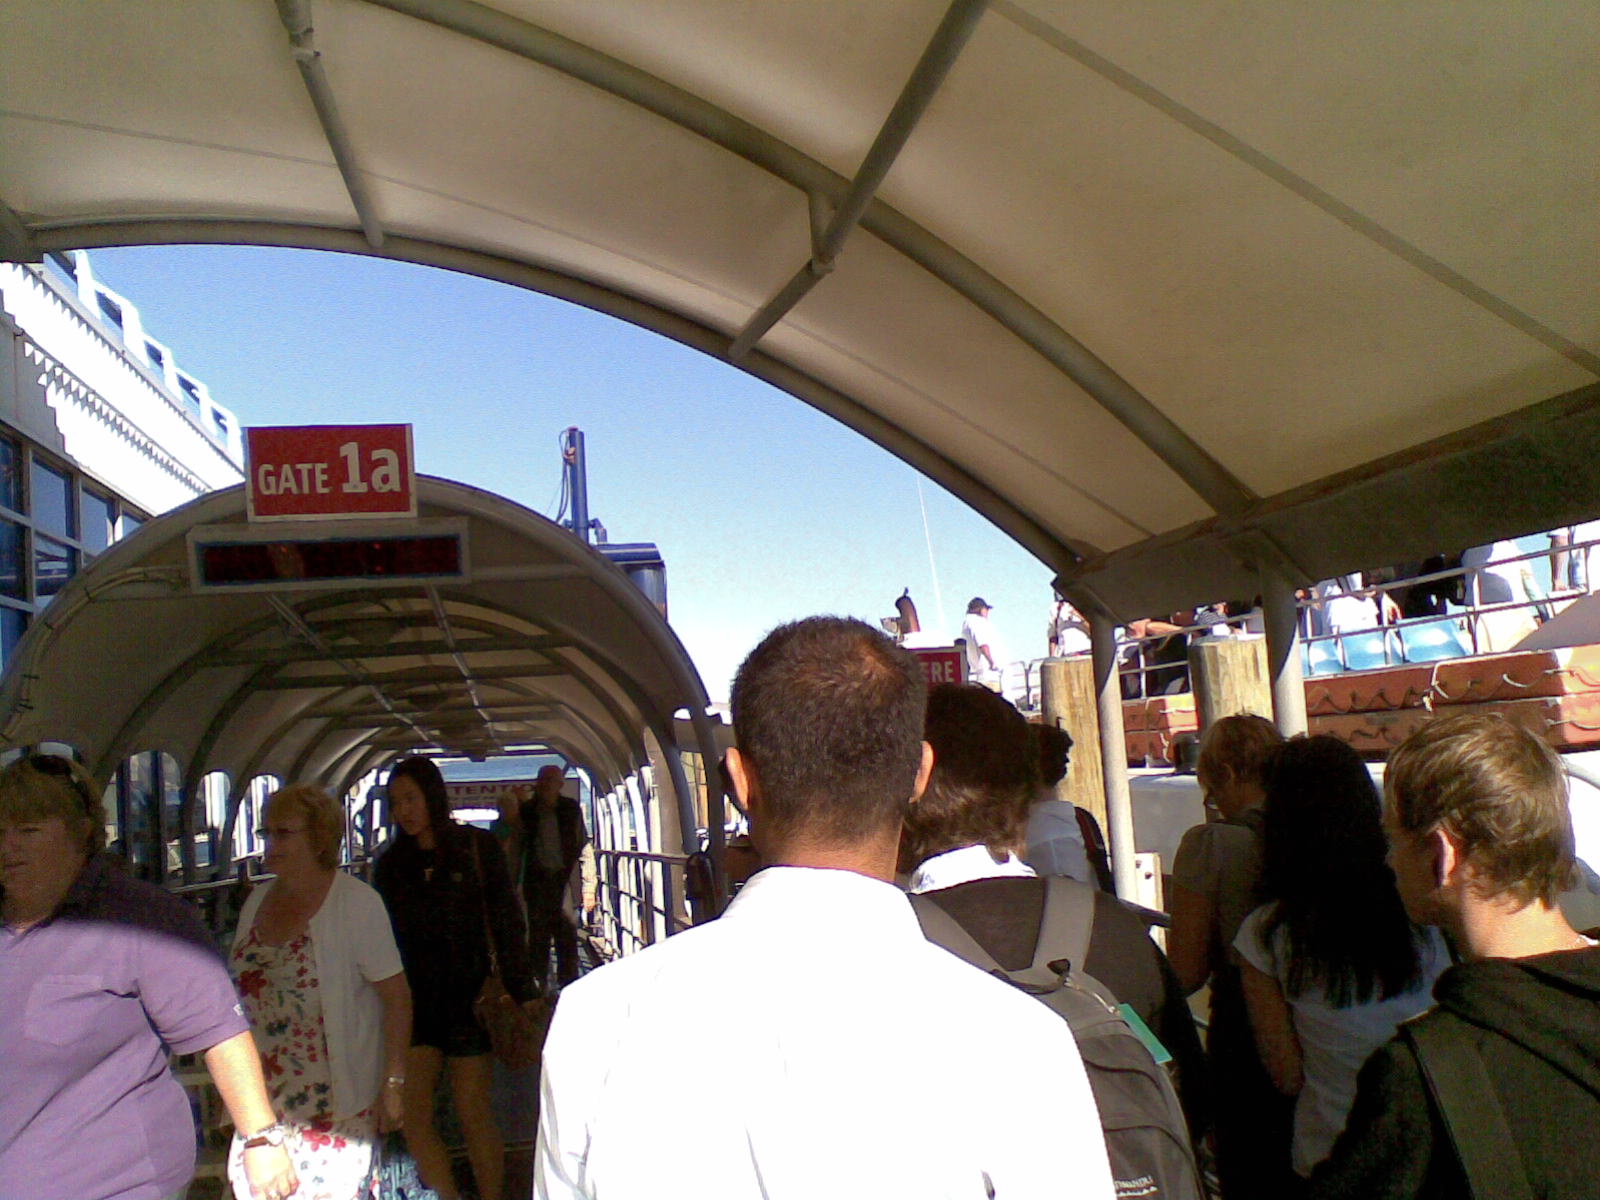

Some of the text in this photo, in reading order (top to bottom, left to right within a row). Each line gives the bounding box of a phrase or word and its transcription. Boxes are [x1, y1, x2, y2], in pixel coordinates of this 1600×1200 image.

[258, 441, 402, 496] GATE 1a
[919, 660, 955, 683] ERE
